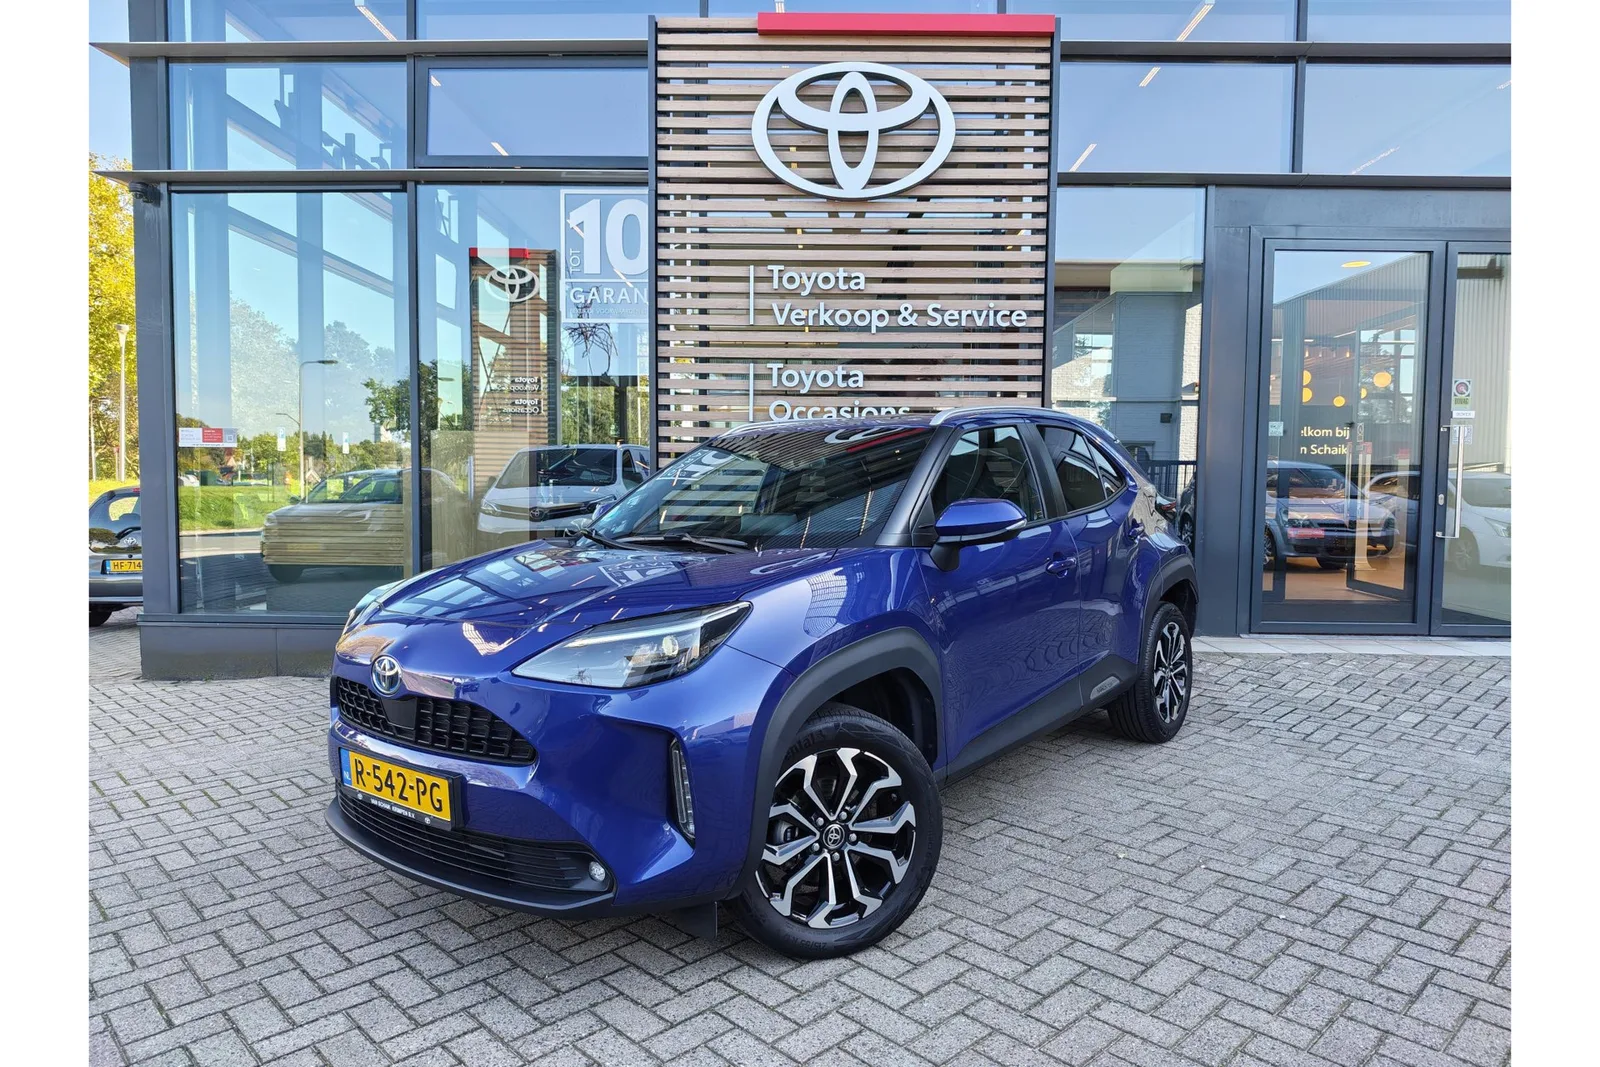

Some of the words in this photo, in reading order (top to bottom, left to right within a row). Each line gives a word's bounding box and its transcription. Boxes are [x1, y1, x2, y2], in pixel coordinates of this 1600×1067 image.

[569, 198, 648, 275] 10
[569, 249, 581, 274] TOT
[767, 265, 866, 296] Toyota
[570, 287, 648, 304] GARAN
[771, 302, 890, 334] Verkoop
[897, 303, 918, 327] &
[926, 302, 1028, 327] Service
[766, 363, 864, 394] Toyota
[1335, 427, 1350, 440] bij
[1310, 444, 1347, 455] Schaik
[343, 770, 352, 781] NL
[354, 758, 443, 813] R-542-PG
